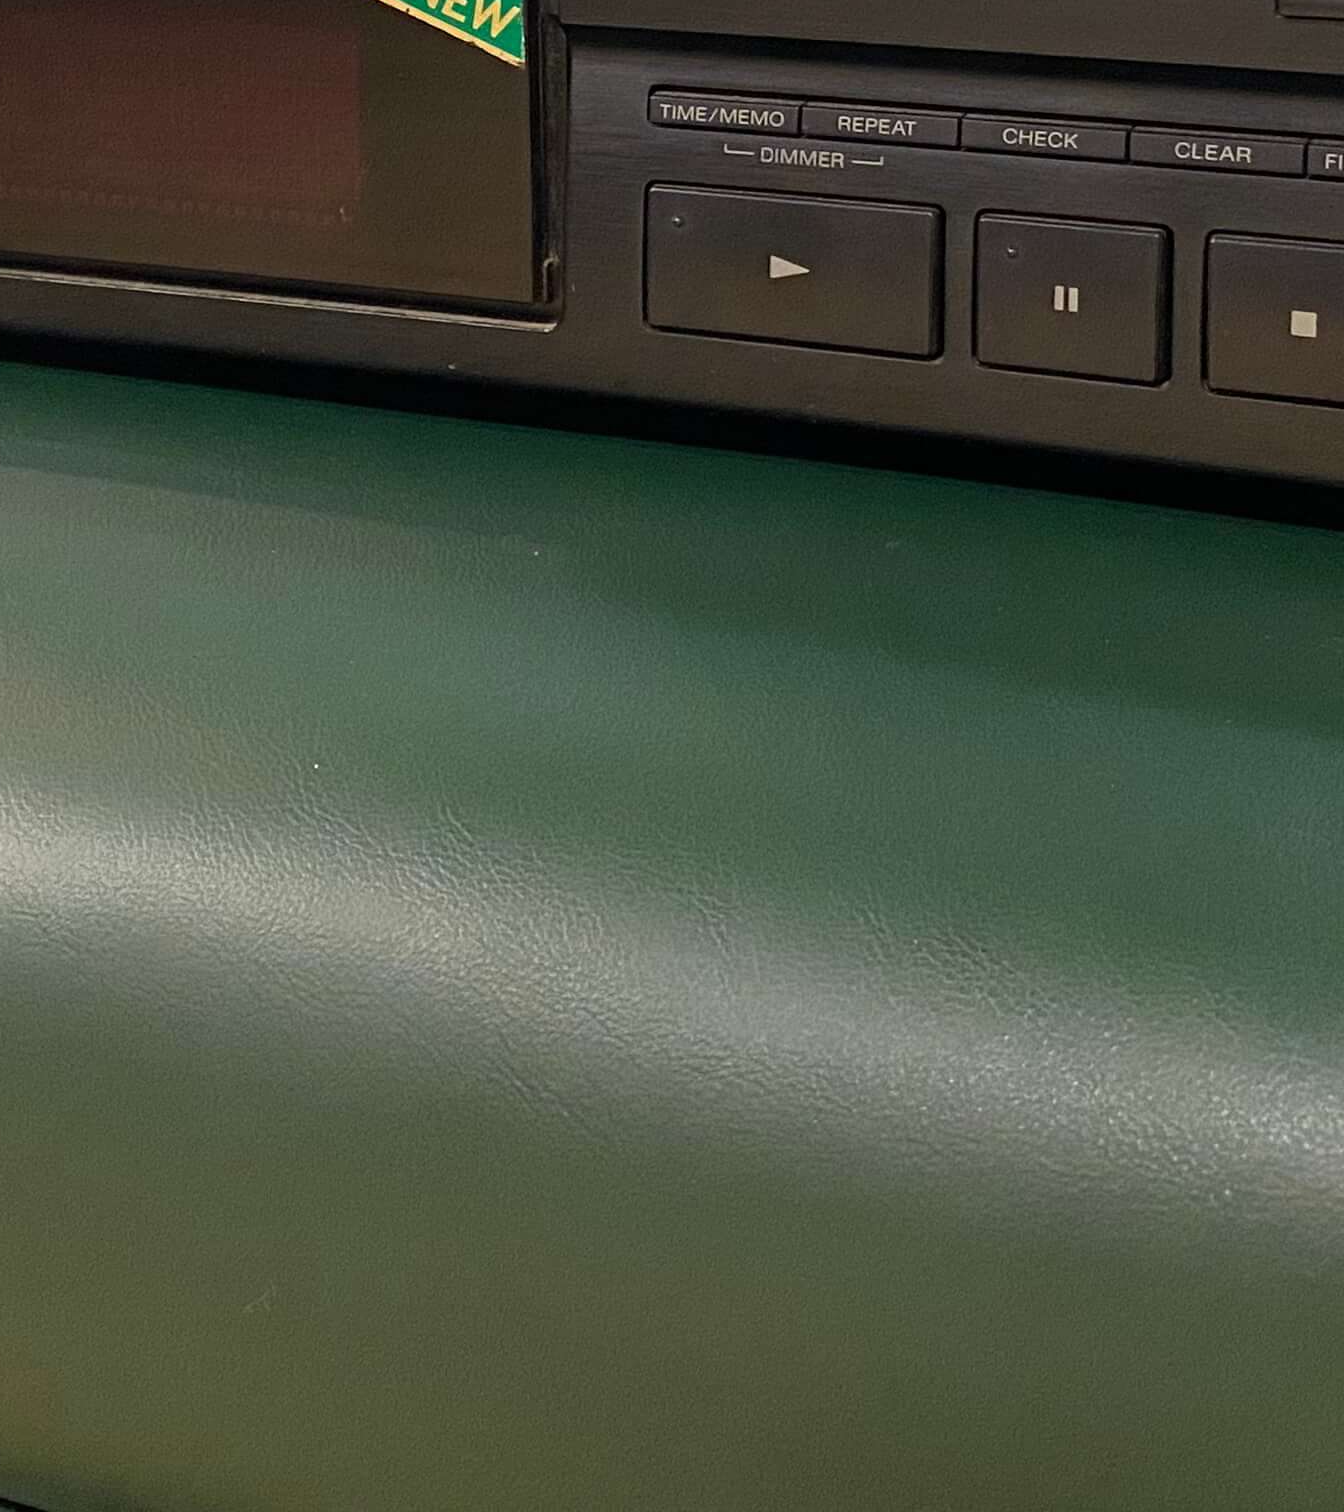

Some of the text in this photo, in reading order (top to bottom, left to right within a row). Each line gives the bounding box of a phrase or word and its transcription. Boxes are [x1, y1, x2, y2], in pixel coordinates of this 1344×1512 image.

[659, 103, 785, 128] TIME/MEMO
[837, 116, 917, 137] REPEAT
[1002, 128, 1079, 150] CHECK
[759, 146, 844, 169] DIMMER
[1174, 141, 1252, 164] CLEAR
